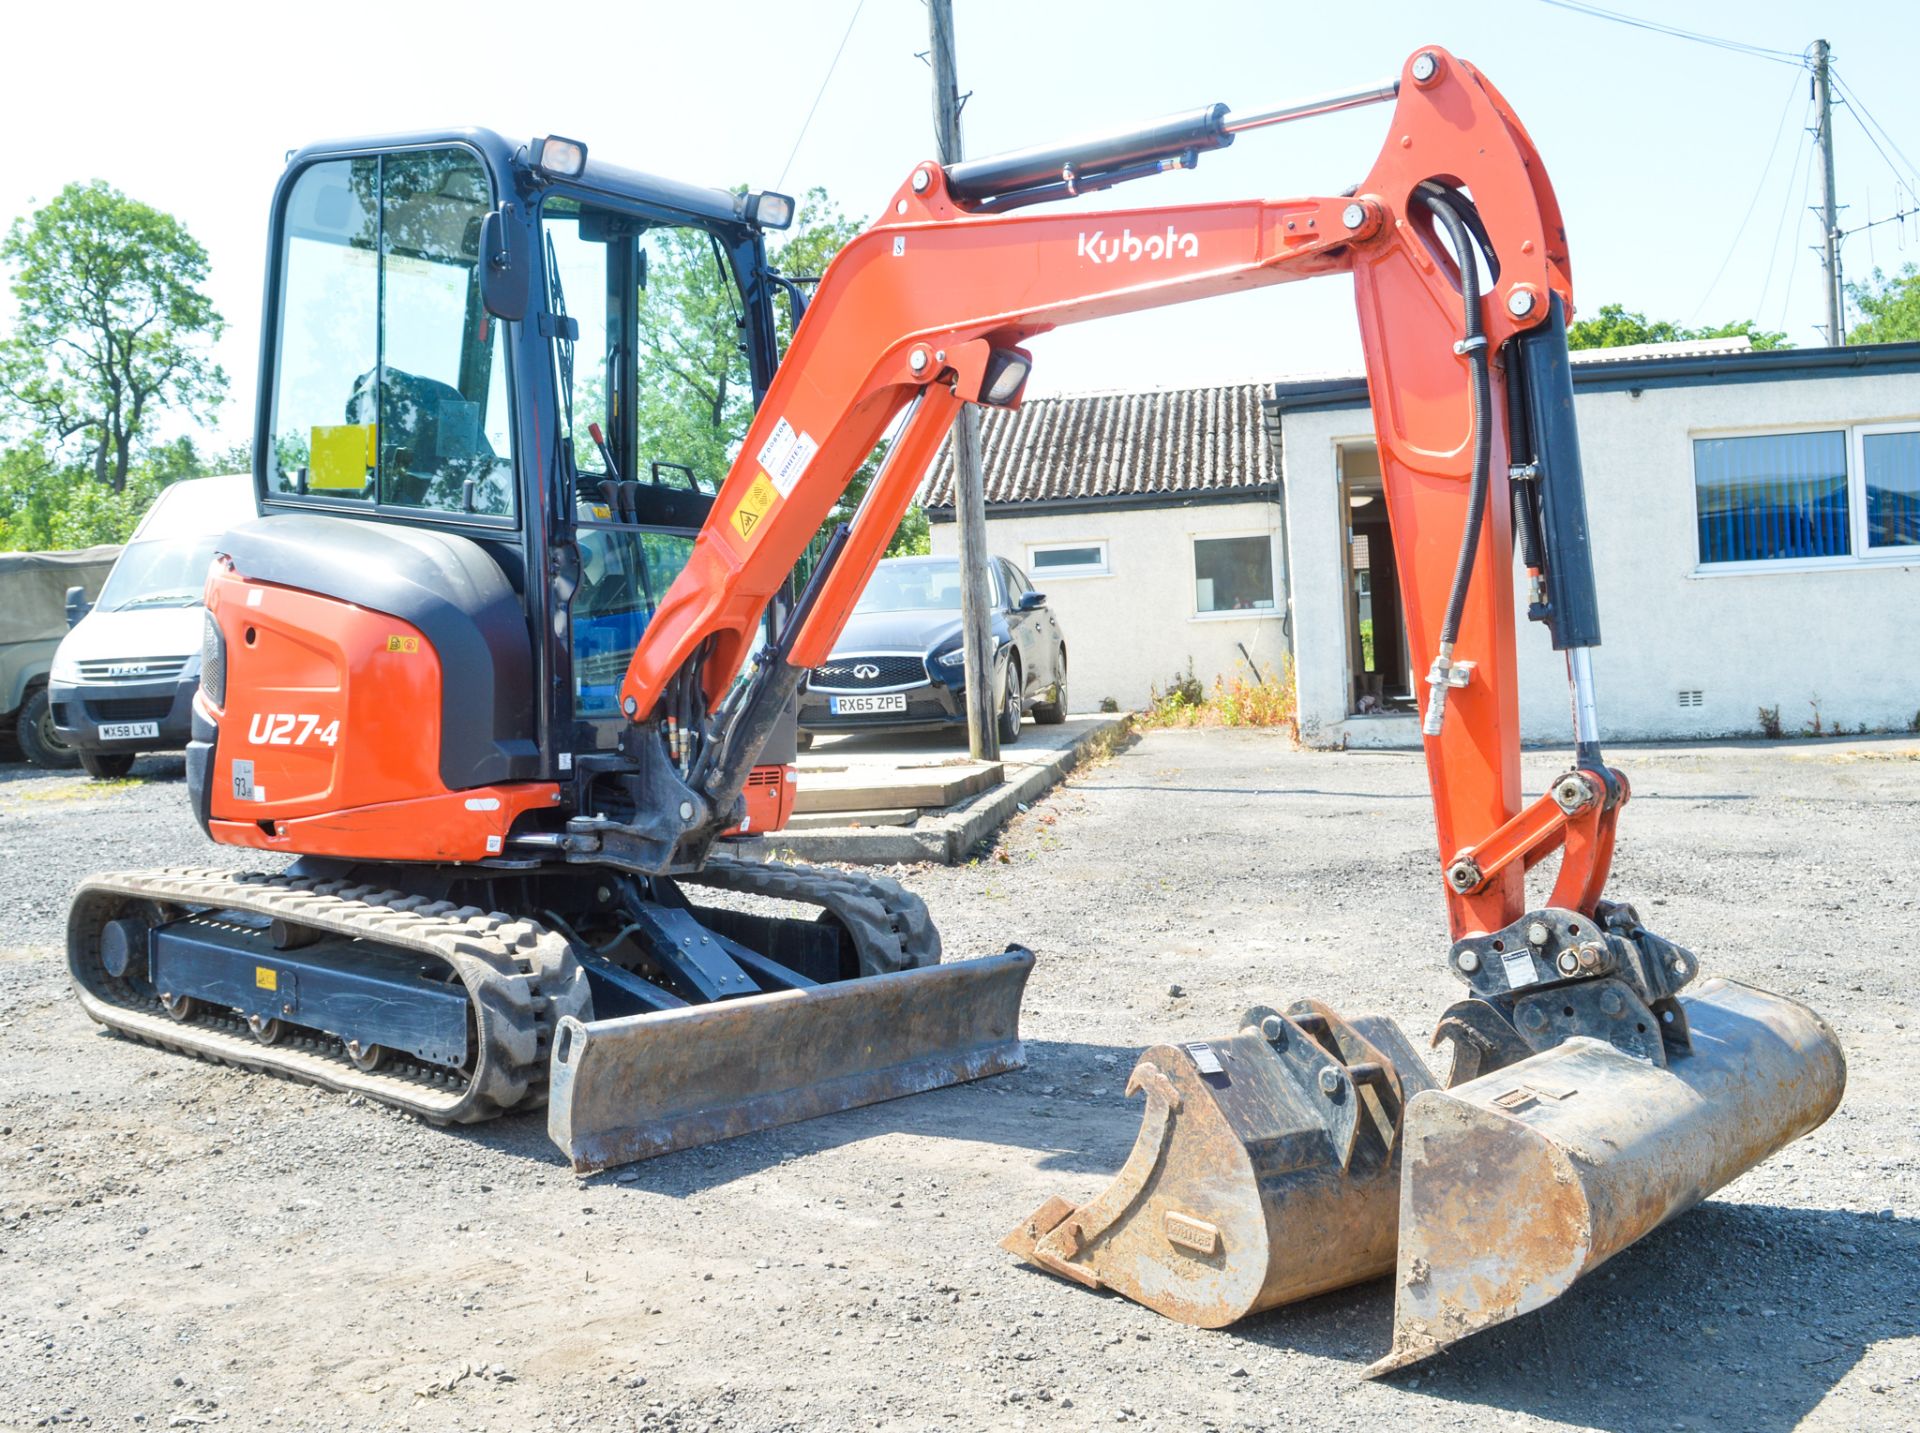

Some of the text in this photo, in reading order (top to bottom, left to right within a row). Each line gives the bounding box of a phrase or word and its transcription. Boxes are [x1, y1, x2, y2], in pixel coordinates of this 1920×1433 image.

[1077, 225, 1199, 264] Kubota
[780, 444, 803, 478] WHITES
[108, 665, 147, 676] IVECO
[839, 696, 903, 711] RX65 ZPE
[103, 724, 153, 738] MX58 LXV
[248, 713, 341, 747] U27-4
[234, 777, 246, 797] 93
